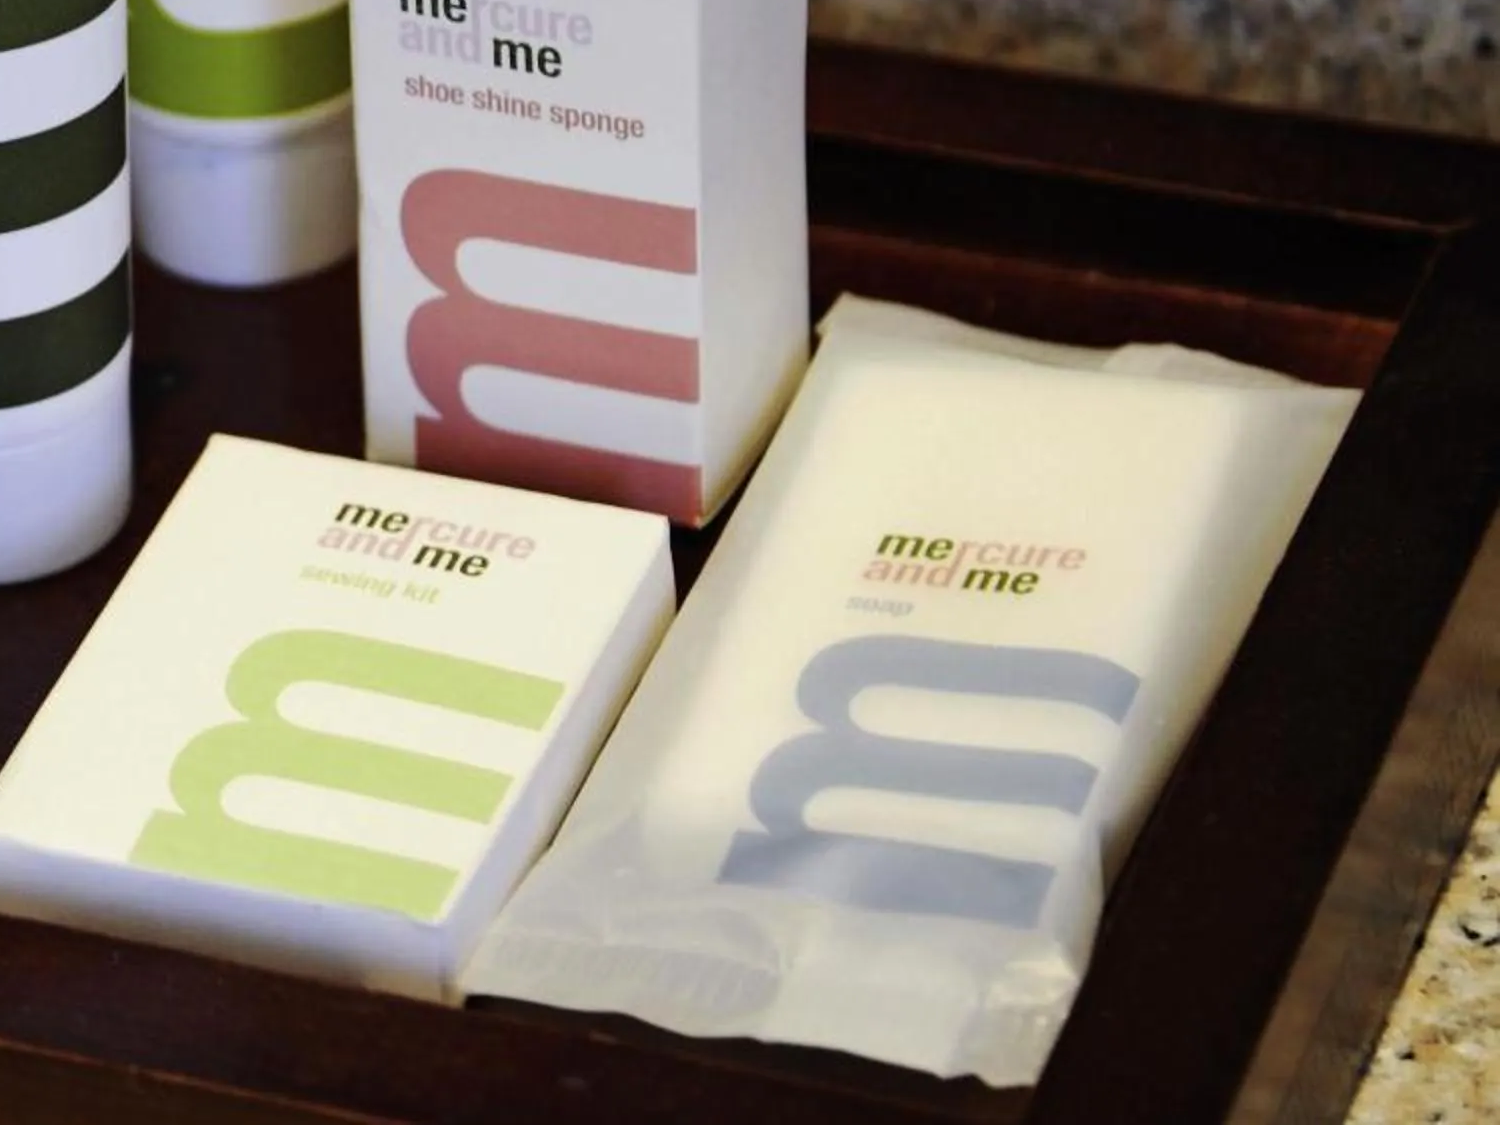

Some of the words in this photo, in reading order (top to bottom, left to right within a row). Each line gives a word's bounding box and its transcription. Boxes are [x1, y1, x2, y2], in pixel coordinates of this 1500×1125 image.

[397, 13, 482, 65] and
[492, 36, 563, 78] me
[404, 74, 464, 106] shoe
[471, 86, 542, 121] shine
[549, 103, 646, 141] sponge
[316, 522, 412, 562] and
[412, 543, 490, 578] me
[334, 502, 537, 560] mercure
[875, 533, 1088, 571] mercure
[401, 580, 441, 605] kit
[861, 557, 959, 589] and
[960, 567, 1040, 595] me
